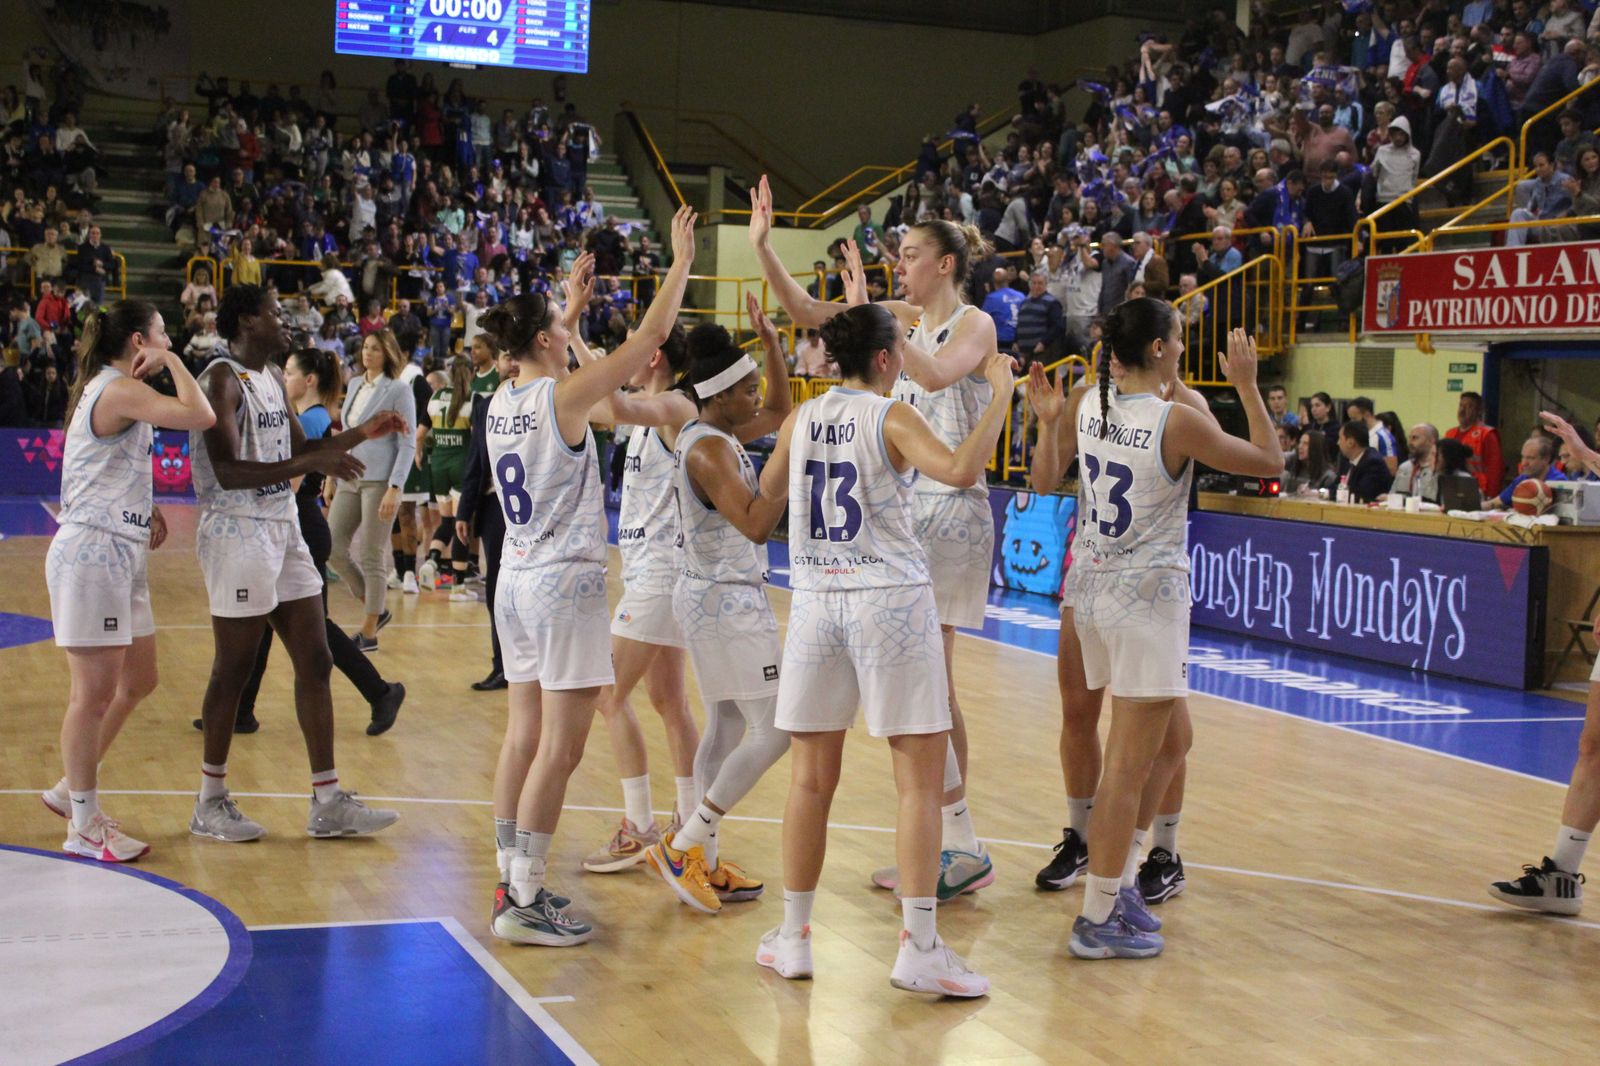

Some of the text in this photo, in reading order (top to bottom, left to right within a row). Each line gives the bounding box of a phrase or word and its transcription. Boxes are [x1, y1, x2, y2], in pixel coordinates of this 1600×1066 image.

[430, 0, 502, 21] 00:00
[434, 25, 443, 41] 1
[487, 30, 498, 46] 4
[1407, 293, 1600, 327] PATRIMONIO DE
[1087, 416, 1152, 449] RORÍGUEZ
[495, 452, 533, 525] 8
[805, 459, 862, 543] 13
[1307, 537, 1467, 671] Mondays
